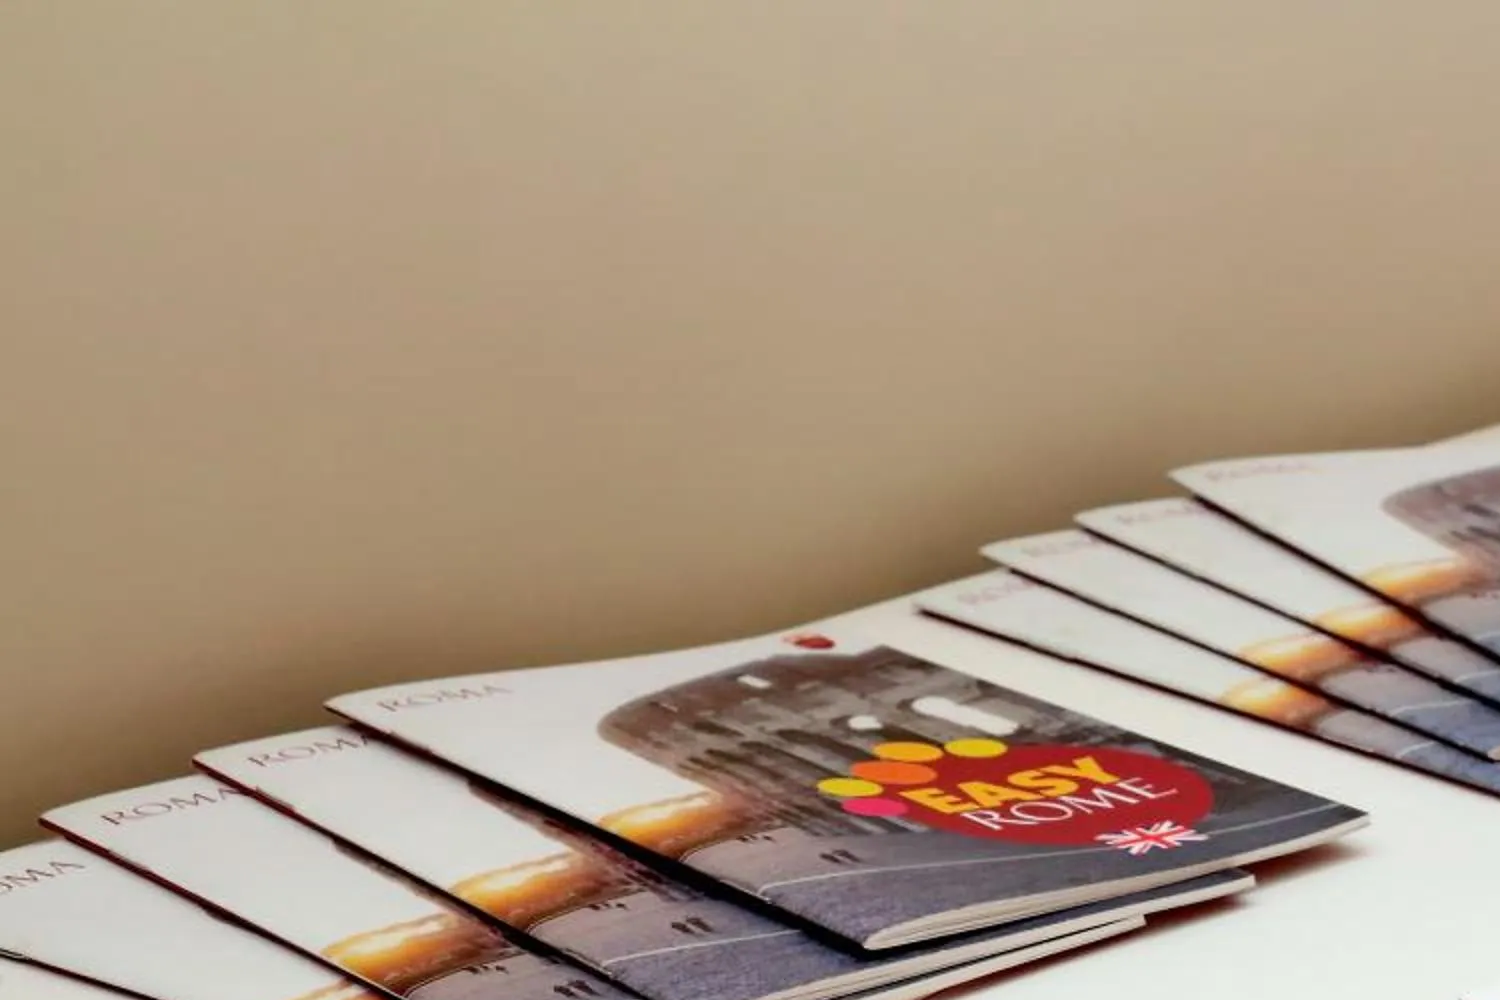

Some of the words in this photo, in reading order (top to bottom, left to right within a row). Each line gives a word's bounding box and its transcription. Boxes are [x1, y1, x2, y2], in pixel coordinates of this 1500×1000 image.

[378, 682, 512, 713] ROMA
[899, 756, 1120, 814] EASY
[960, 776, 1179, 832] ROME
